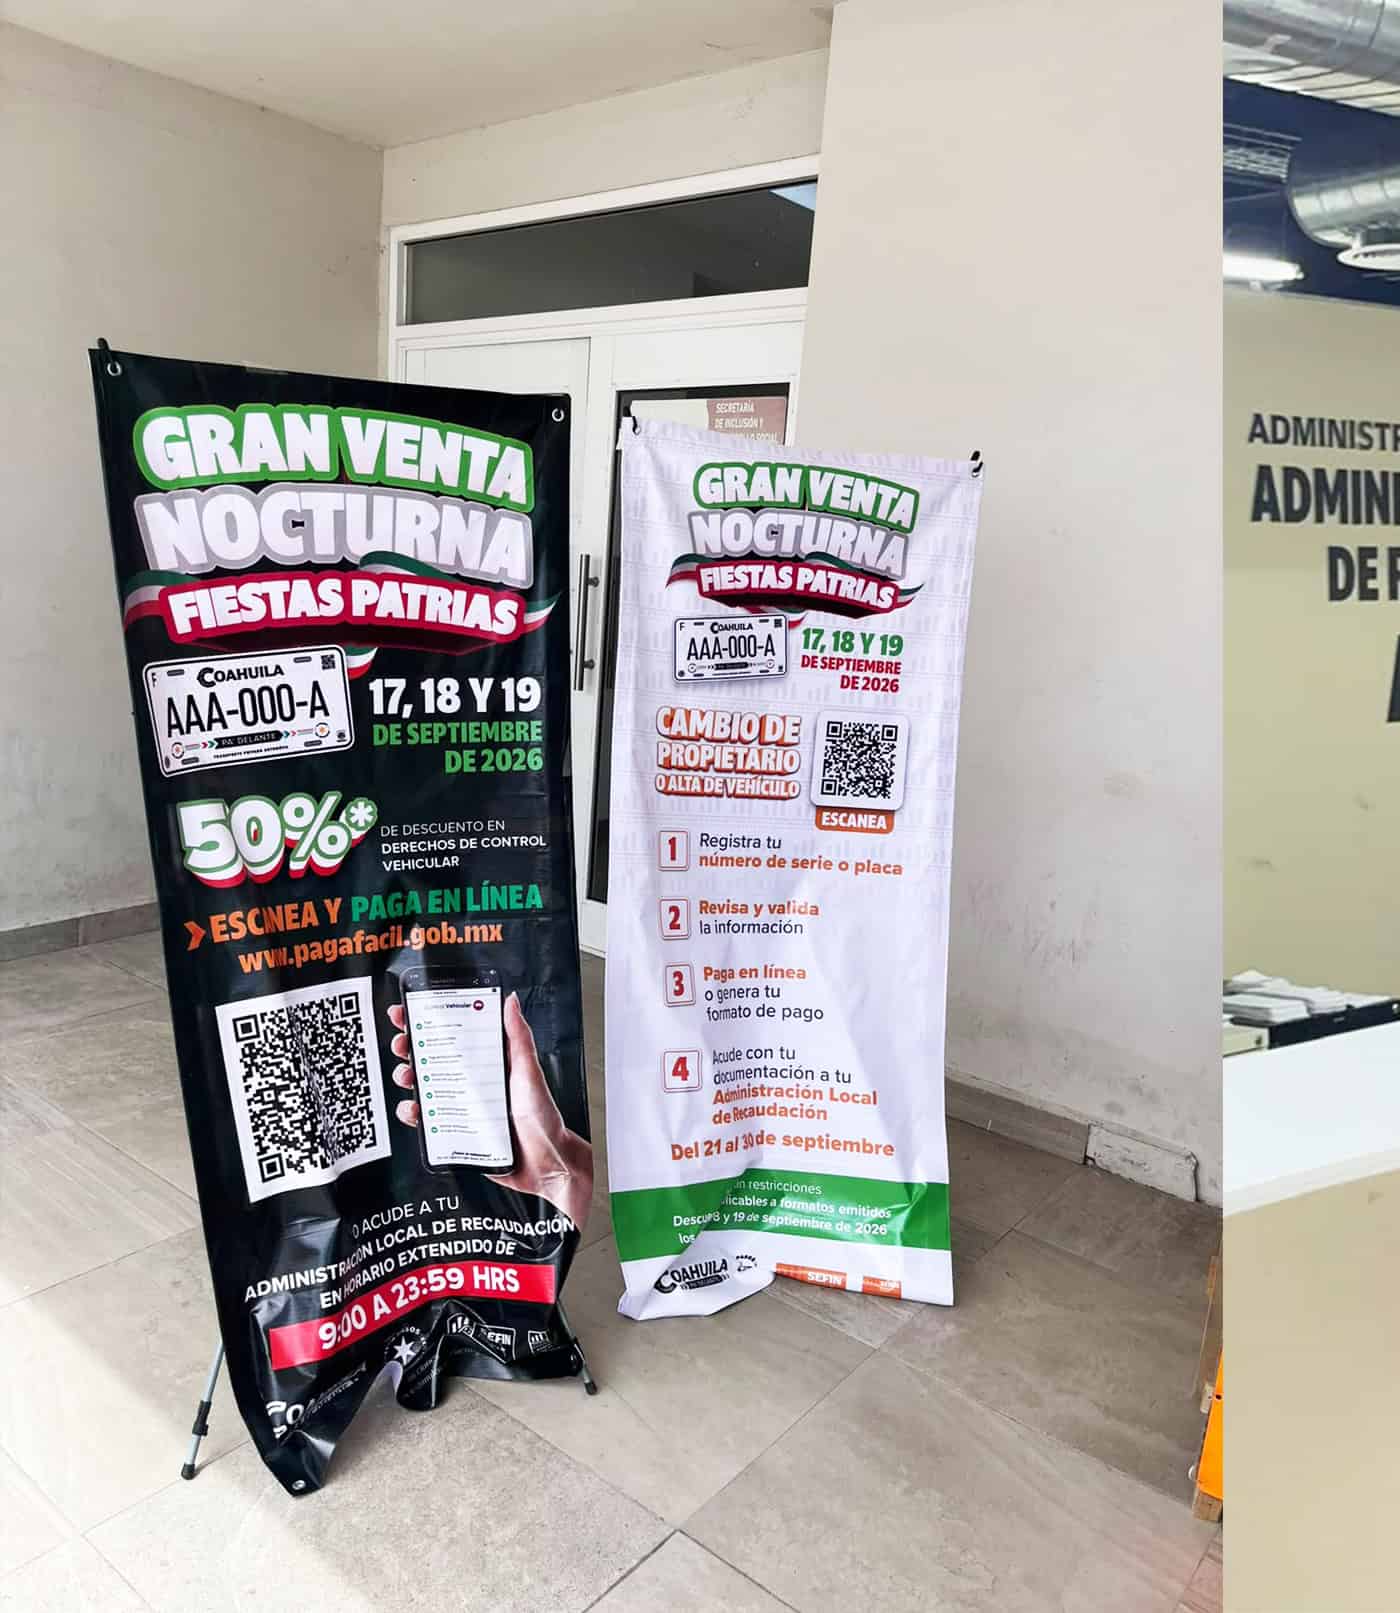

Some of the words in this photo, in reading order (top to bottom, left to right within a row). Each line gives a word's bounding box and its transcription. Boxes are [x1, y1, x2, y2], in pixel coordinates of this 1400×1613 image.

[715, 418, 723, 428] DE
[141, 413, 331, 482] GRAN
[341, 415, 527, 505] VENTA
[699, 467, 802, 505] GRAN
[808, 468, 916, 529] VENTA
[142, 490, 527, 582] NOCTURNA
[693, 513, 906, 575] NOCTURNA
[1327, 546, 1379, 601] DE
[701, 565, 792, 593] FIESTAS
[795, 569, 895, 609] PATRIAS
[167, 578, 343, 635] FIESTAS
[351, 580, 519, 636] PATRIAS
[679, 623, 685, 631] F
[710, 622, 754, 634] COAHUILA
[687, 634, 776, 661] AAA-000-A
[802, 628, 826, 654] 17,
[832, 630, 854, 652] 18
[860, 633, 874, 654] Y
[880, 634, 904, 656] 19
[197, 665, 284, 688] COAHUILA
[801, 655, 820, 668] DE
[821, 656, 901, 674] SEPTIEMBRE
[840, 675, 859, 690] DE
[862, 676, 899, 692] 2026
[168, 680, 330, 738] AAA-000-A
[369, 679, 413, 719] 17,
[420, 681, 462, 713] 18
[463, 677, 493, 713] Y
[502, 677, 541, 712] 19
[373, 723, 404, 746] DE
[407, 721, 543, 745] SEPTIEMBRE
[656, 706, 760, 742] CAMBIO
[762, 716, 801, 743] DE
[445, 751, 477, 773] DE
[480, 749, 544, 772] 2026
[657, 742, 800, 774] PROPIETARIO
[656, 774, 665, 791] O
[668, 775, 700, 791] ALTA
[704, 776, 725, 793] DE
[725, 776, 800, 798] VEHÍCULO
[380, 824, 400, 837] DE
[402, 821, 484, 836] DESCUENTO
[487, 820, 505, 832] EN
[822, 812, 888, 830] ESCANEA
[382, 839, 456, 855] DERECHOS
[460, 837, 478, 850] DE
[481, 835, 546, 849] CONTROL
[668, 836, 677, 861] 1
[700, 833, 761, 850] Registra
[766, 835, 782, 849] tu
[382, 856, 460, 871] VEHICULAR
[700, 852, 762, 868] número
[766, 855, 786, 868] de
[792, 856, 832, 870] serie
[838, 861, 849, 871] o
[854, 861, 903, 876] placa
[323, 898, 342, 924] Y
[351, 892, 422, 922] PAGA
[428, 888, 461, 913] EN
[466, 880, 544, 911] LÍNEA
[700, 900, 748, 915] Revisa
[754, 904, 763, 918] y
[768, 901, 819, 916] valida
[668, 906, 681, 930] 2
[700, 920, 711, 934] la
[714, 920, 804, 934] información
[673, 971, 684, 996] 3
[704, 966, 735, 983] Paga
[739, 967, 758, 978] en
[764, 964, 806, 979] línea
[705, 989, 714, 1001] o
[717, 986, 760, 1003] genera
[765, 985, 780, 998] tu
[707, 1003, 751, 1022] formato
[756, 1003, 776, 1017] de
[782, 1006, 824, 1022] pago
[712, 1048, 742, 1064] Acude
[745, 1047, 774, 1060] con
[780, 1046, 796, 1060] tu
[672, 1056, 690, 1081] 4
[713, 1064, 814, 1084] documentación
[820, 1069, 829, 1082] a
[834, 1068, 851, 1083] tu
[712, 1083, 824, 1105] Administración
[829, 1088, 877, 1105] Local
[712, 1110, 731, 1124] de
[733, 1102, 827, 1122] Recaudación
[672, 1143, 699, 1161] Del
[704, 1141, 722, 1156] 21
[725, 1135, 738, 1153] al
[743, 1133, 755, 1149] 30
[755, 1130, 776, 1145] de
[782, 1133, 895, 1156] septiembre
[749, 1180, 822, 1194] restricciones
[362, 1205, 415, 1234] ACUDE
[419, 1200, 433, 1213] A
[436, 1195, 459, 1211] TU
[770, 1198, 776, 1207] a
[780, 1197, 835, 1212] formatos
[838, 1204, 892, 1218] emitidos
[376, 1224, 428, 1254] LOCAL
[432, 1219, 457, 1235] DE
[462, 1215, 575, 1236] RECAUDACIÓN
[723, 1213, 730, 1224] y
[734, 1212, 746, 1222] 19
[746, 1212, 760, 1222] de
[762, 1214, 832, 1230] septiembre
[835, 1220, 851, 1232] de
[855, 1222, 888, 1236] 2026
[320, 1286, 342, 1309] EN
[342, 1258, 395, 1297] HORARIO
[398, 1238, 493, 1266] EXTENDIDO
[496, 1241, 517, 1255] DE
[654, 1258, 728, 1294] COAHUILA
[318, 1304, 368, 1351] 9:00
[373, 1294, 391, 1321] A
[395, 1268, 466, 1310] 23:59
[472, 1267, 520, 1293] HRS
